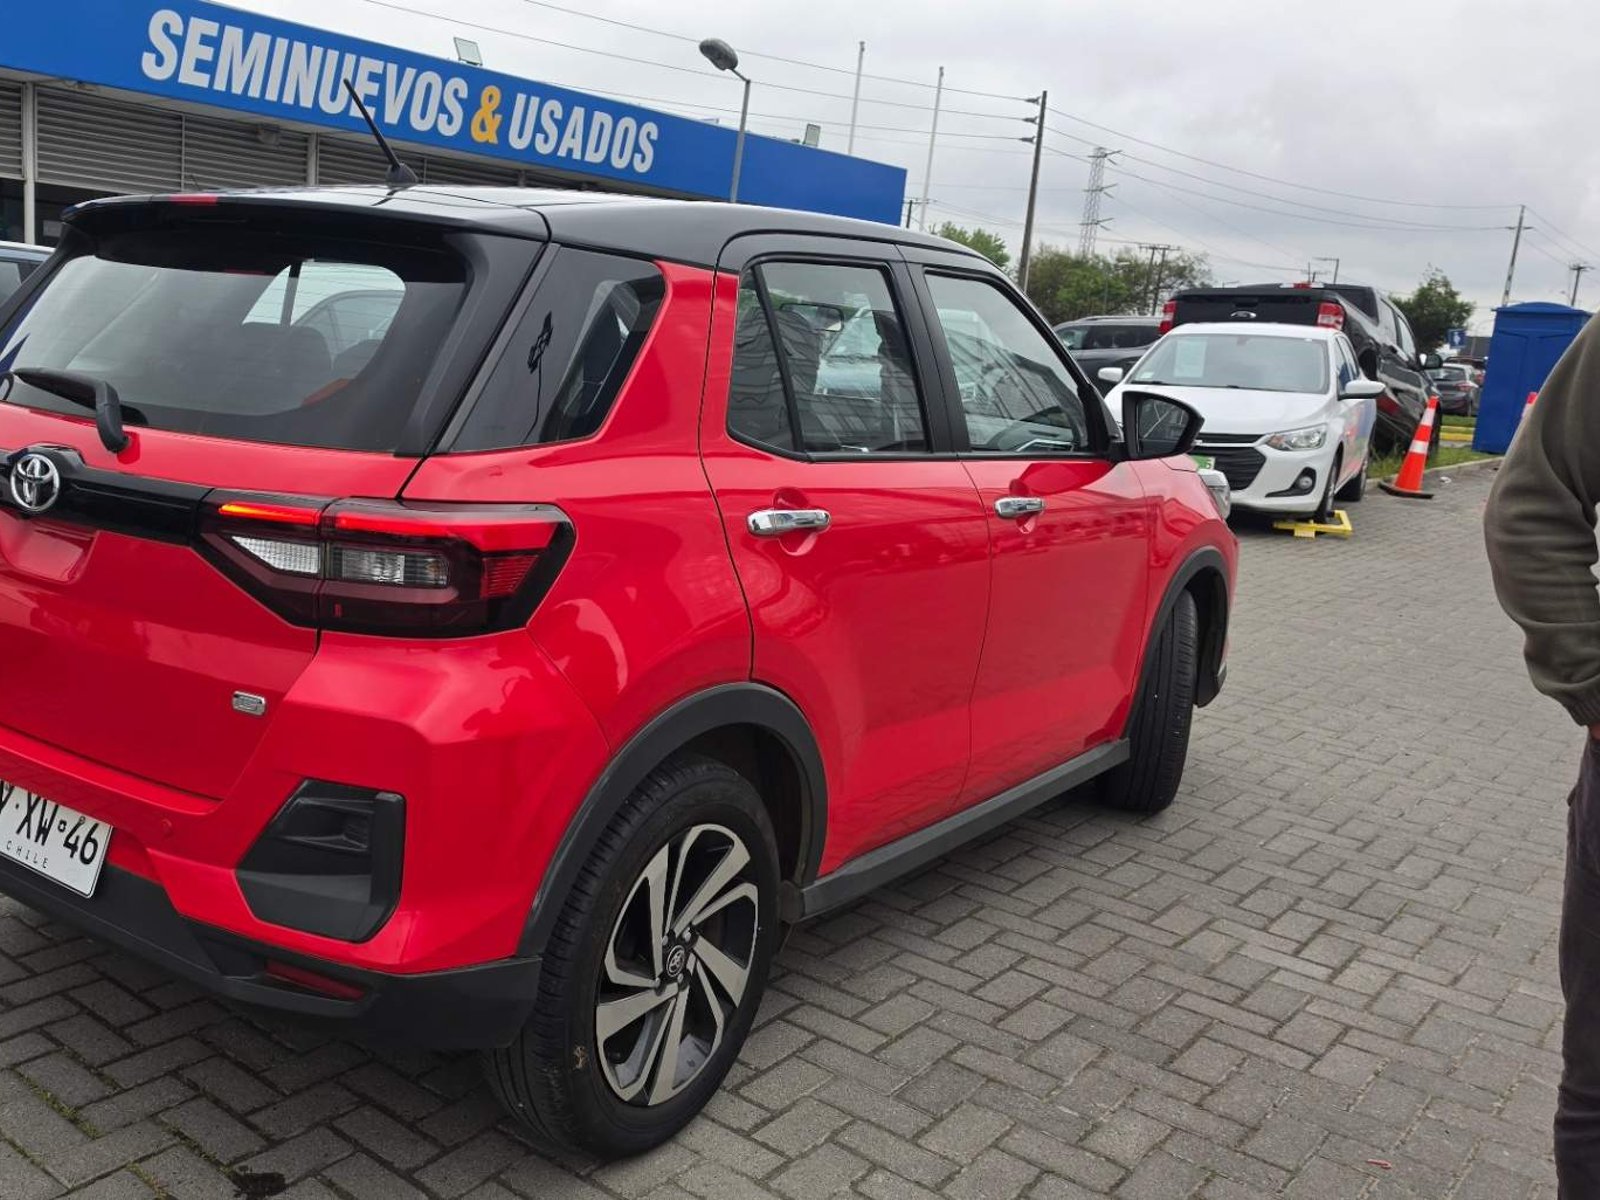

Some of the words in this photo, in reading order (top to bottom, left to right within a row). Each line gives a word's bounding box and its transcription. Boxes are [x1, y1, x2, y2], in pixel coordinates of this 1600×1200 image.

[141, 9, 468, 137] SEMINUEVOS
[470, 85, 502, 144] &
[508, 93, 658, 173] USADOS
[6, 840, 48, 869] CHILE
